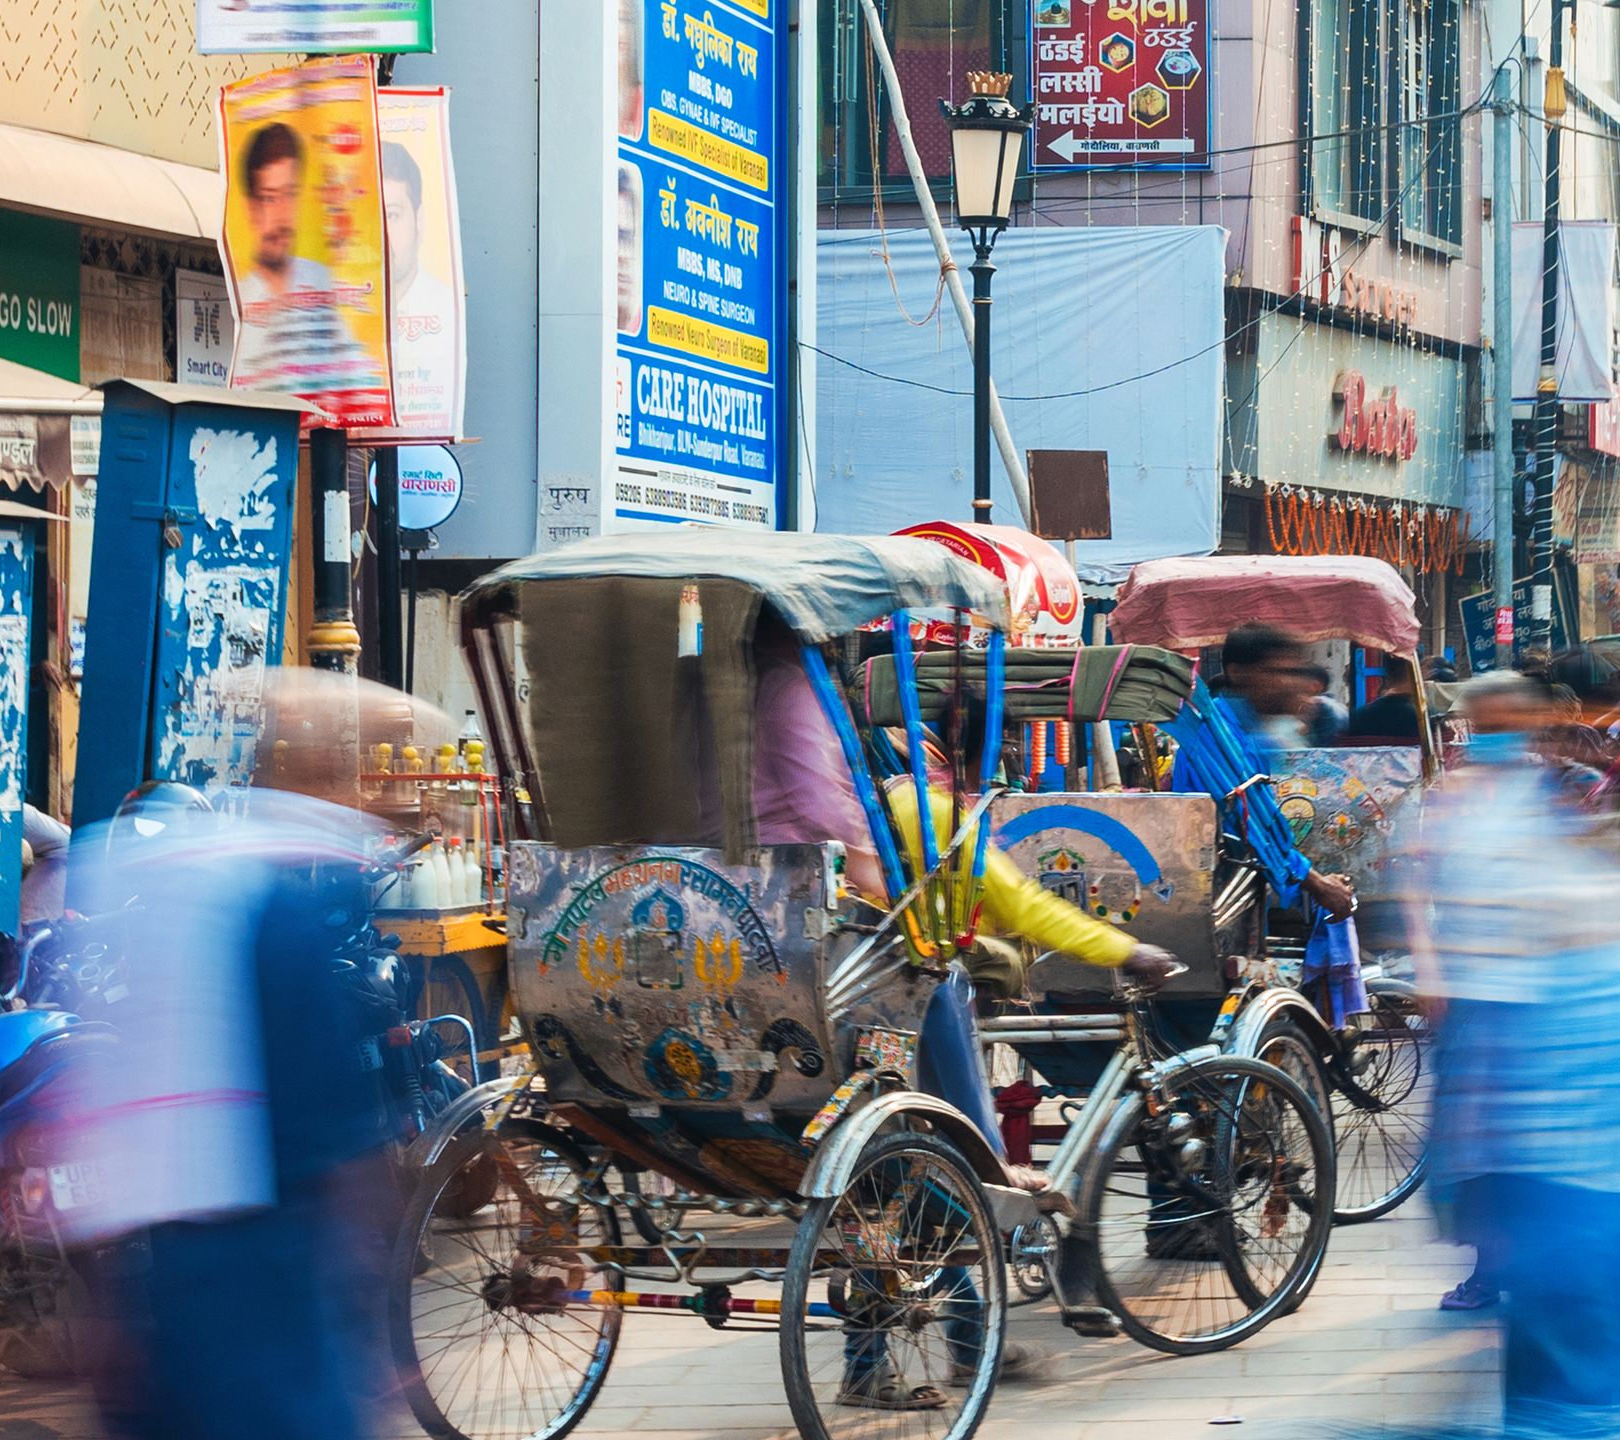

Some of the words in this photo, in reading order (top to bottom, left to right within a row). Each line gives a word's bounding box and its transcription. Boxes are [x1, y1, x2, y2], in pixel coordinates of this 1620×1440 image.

[684, 10, 733, 70] मधुलिका
[736, 41, 758, 80] राय
[1039, 33, 1086, 65] ठंडई
[1143, 21, 1198, 50] ठंडई
[689, 70, 715, 105] MBBS,
[715, 82, 733, 109] DGO
[1039, 66, 1102, 93] लस्सी
[661, 89, 679, 113] OBS,
[721, 116, 757, 147] SPECIALIST
[1038, 97, 1125, 127] मलईयो
[659, 175, 680, 230] डॉ.
[685, 193, 732, 250] अवनीश
[735, 218, 759, 259] राय
[677, 246, 705, 282] MBBS,
[707, 257, 723, 288] MS,
[724, 263, 742, 290] DNB
[26, 296, 72, 338] SLOW
[664, 280, 690, 306] NEURO
[698, 291, 720, 315] SPINE
[720, 298, 755, 325] SURGEON
[187, 358, 209, 376] Smart
[211, 361, 229, 381] City
[637, 364, 684, 422] CARE
[687, 375, 766, 440] HOSPITAL
[638, 421, 677, 456] Bhikharipur,
[400, 478, 457, 494] वाराणसी
[549, 486, 591, 511] पुरुष
